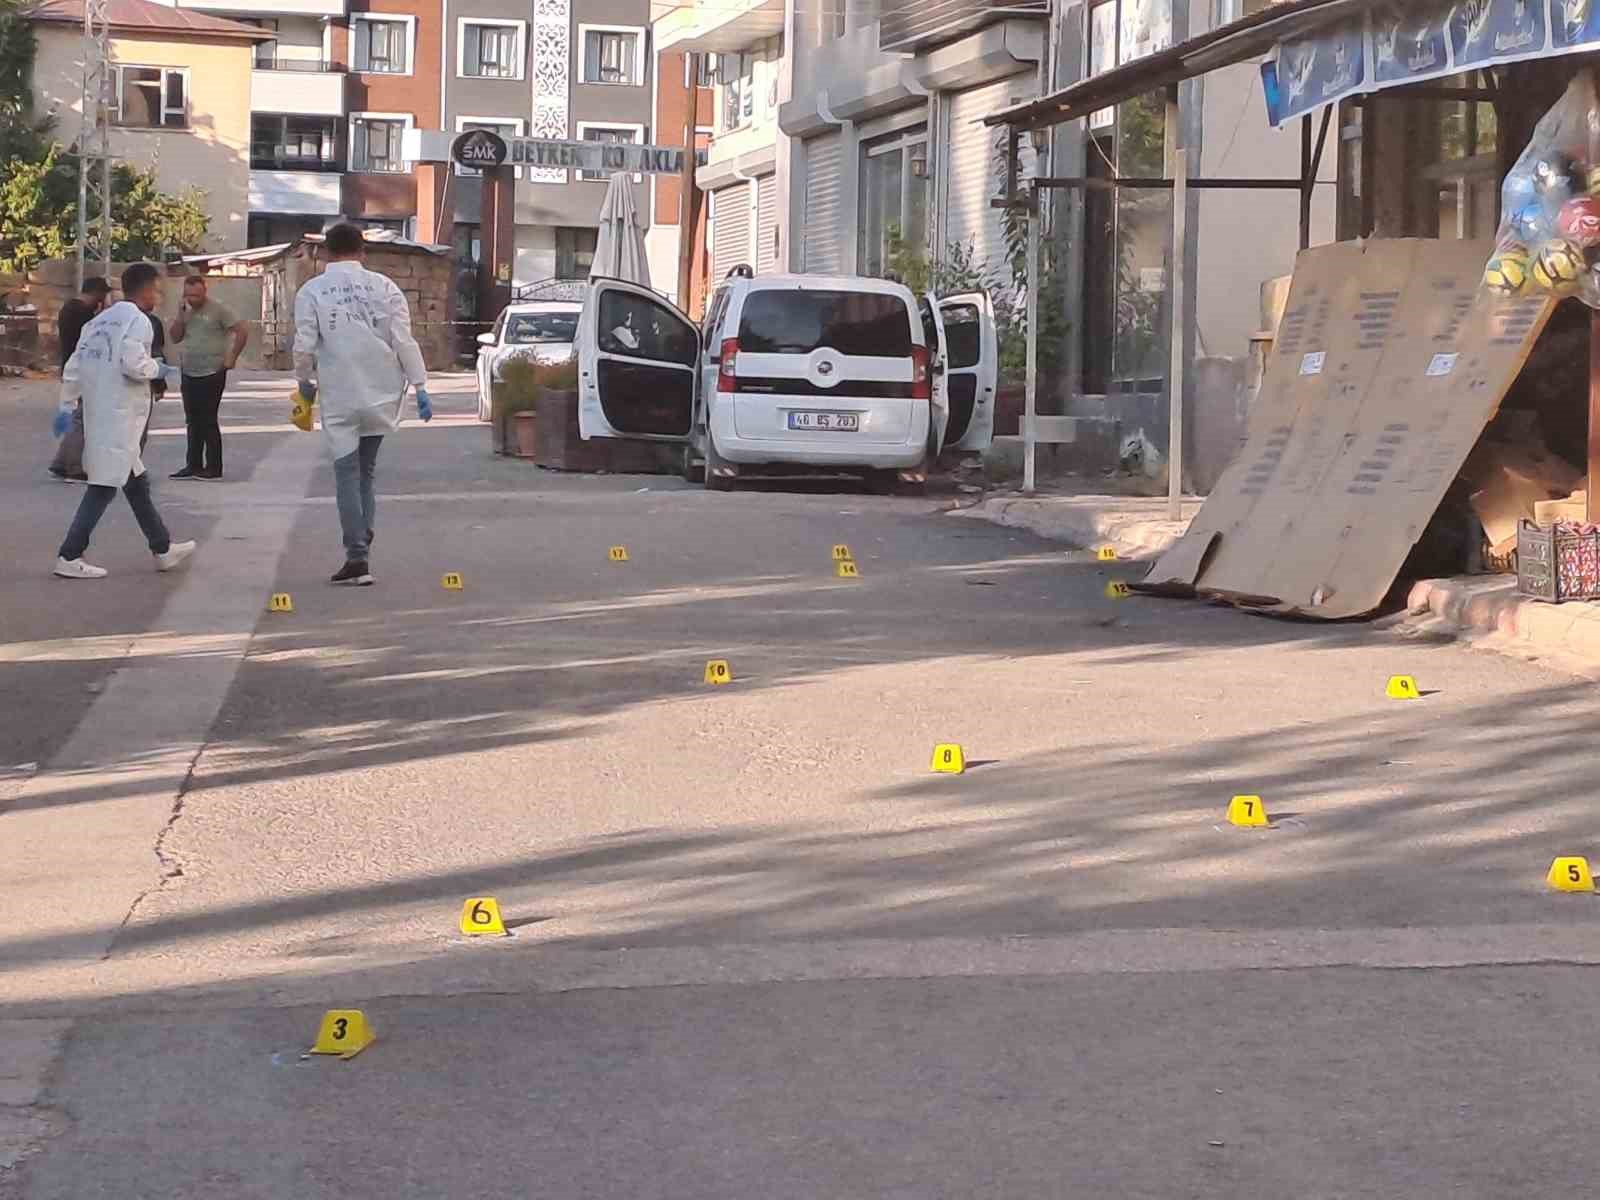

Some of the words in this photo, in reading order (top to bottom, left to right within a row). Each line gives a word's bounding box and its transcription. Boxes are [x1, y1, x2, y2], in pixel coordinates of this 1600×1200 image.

[463, 144, 497, 159] SMK
[612, 548, 624, 558] 17
[843, 564, 855, 574] 14
[446, 575, 458, 585] 13
[1113, 583, 1128, 593] 12
[275, 595, 287, 607] 11
[1400, 681, 1408, 691] 9
[943, 749, 951, 763] 8
[1243, 802, 1254, 817] 7
[1567, 864, 1580, 882] 5
[471, 901, 492, 924] 6
[332, 1017, 348, 1040] 3
